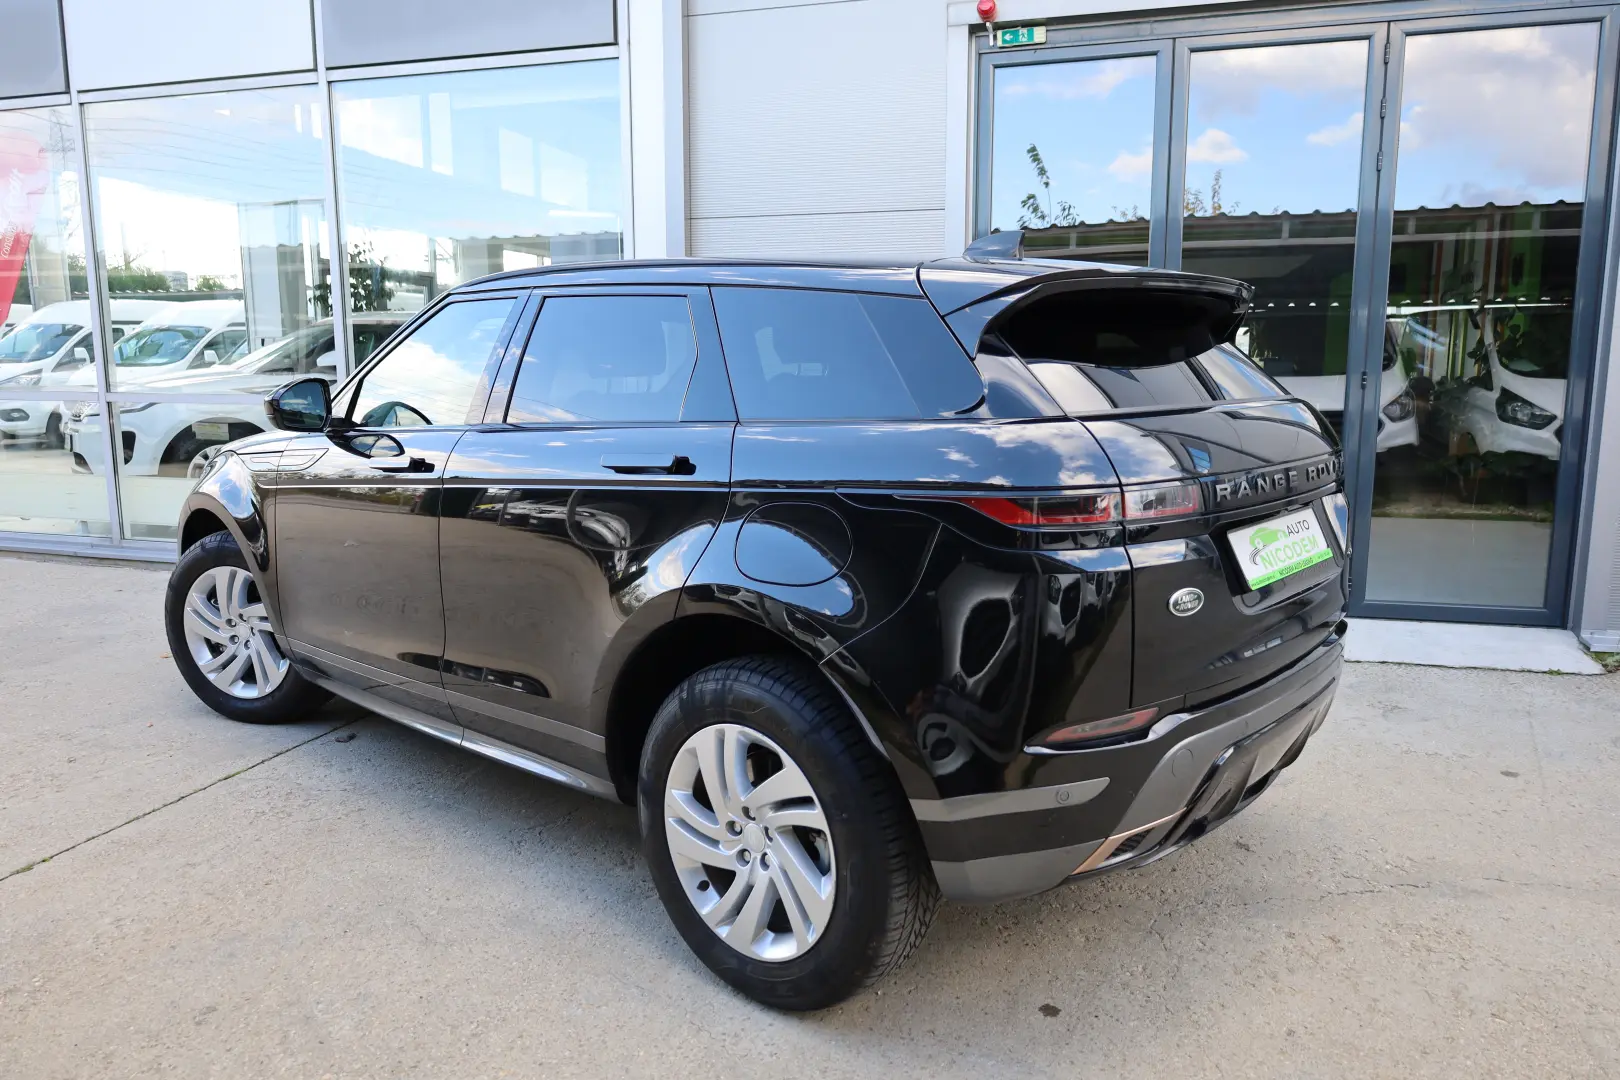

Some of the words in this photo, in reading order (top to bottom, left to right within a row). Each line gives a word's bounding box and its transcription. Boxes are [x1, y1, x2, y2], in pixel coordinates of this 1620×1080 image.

[1215, 470, 1299, 502] RANGE
[1306, 456, 1344, 482] ROV
[1286, 519, 1310, 537] AUTO
[1259, 535, 1320, 570] NICODEM
[1177, 593, 1194, 604] LAND
[1178, 599, 1199, 611] ROVER
